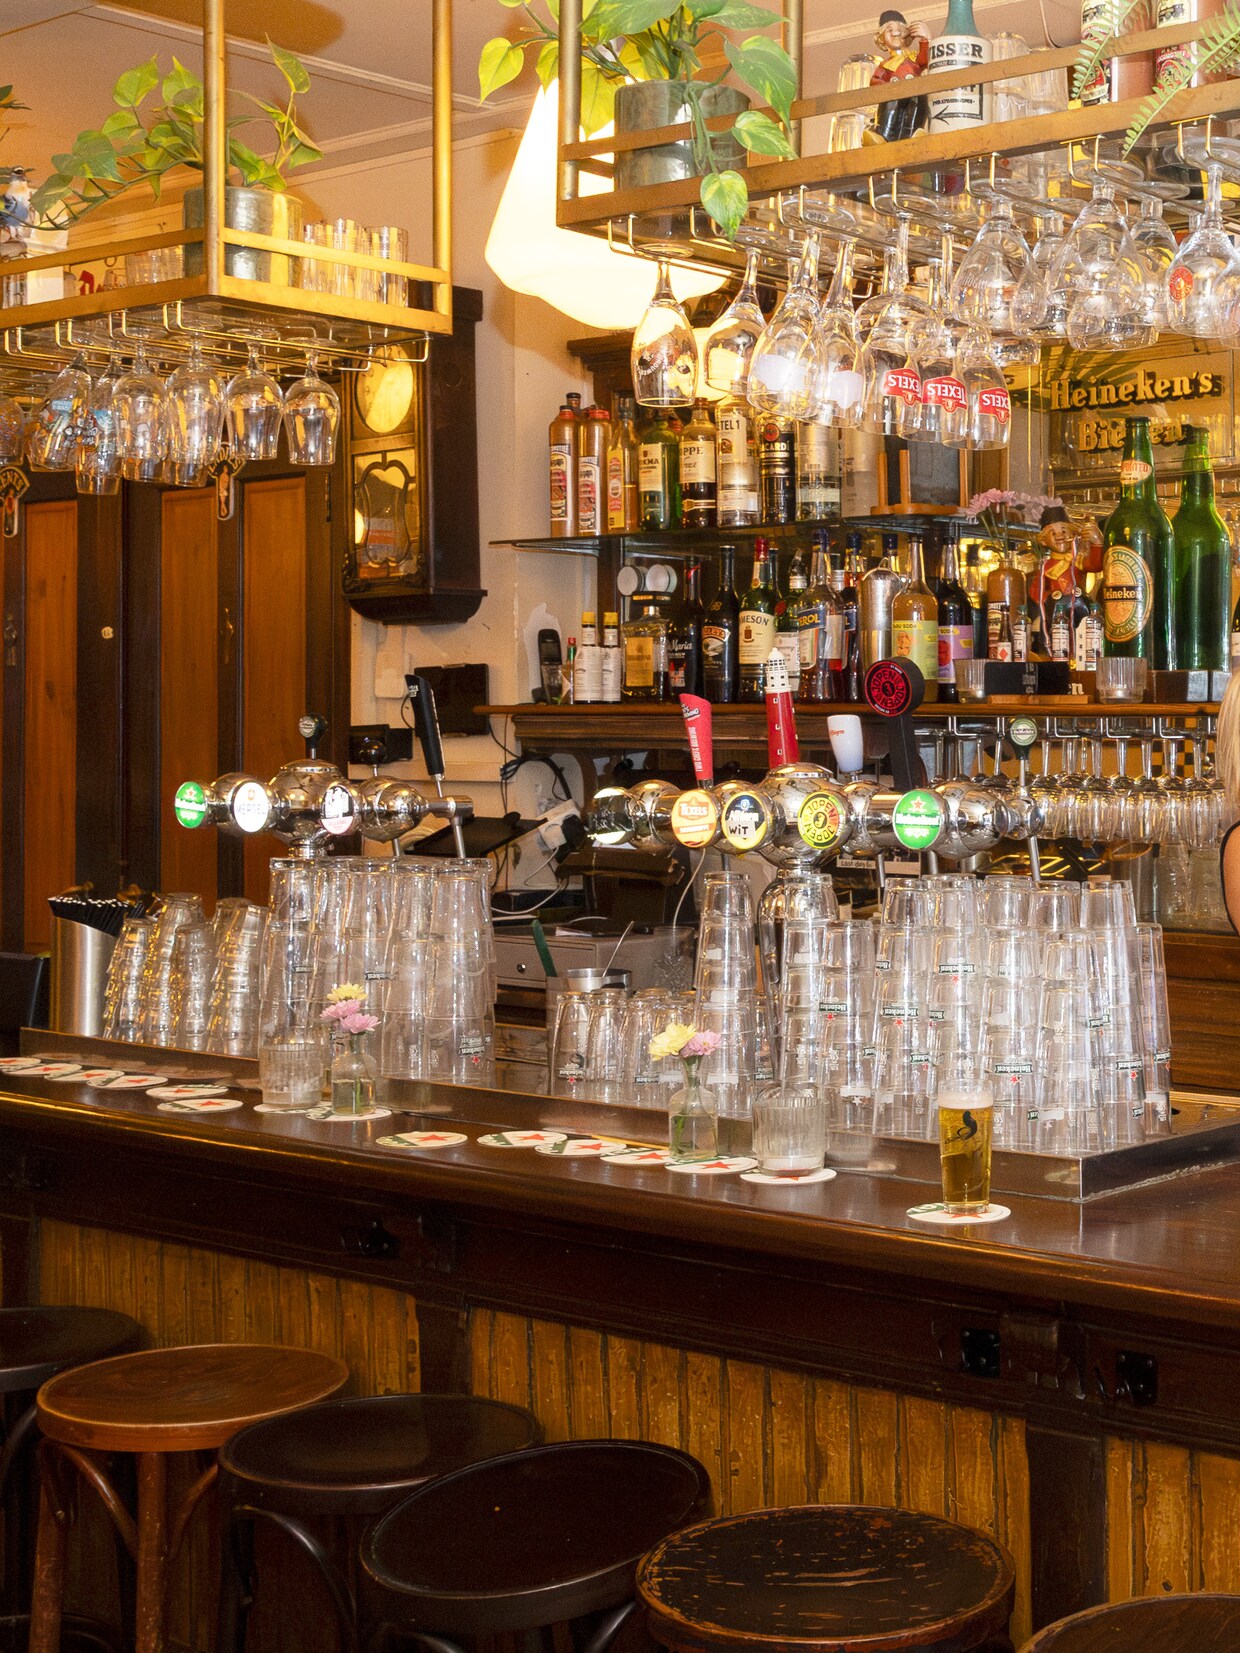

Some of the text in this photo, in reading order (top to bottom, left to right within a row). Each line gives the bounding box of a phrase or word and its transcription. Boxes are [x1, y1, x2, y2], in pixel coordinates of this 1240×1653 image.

[928, 43, 983, 60] ISSER
[982, 393, 1010, 406] XELS
[1050, 369, 1213, 411] Heineken's
[1077, 418, 1184, 451] Bieen
